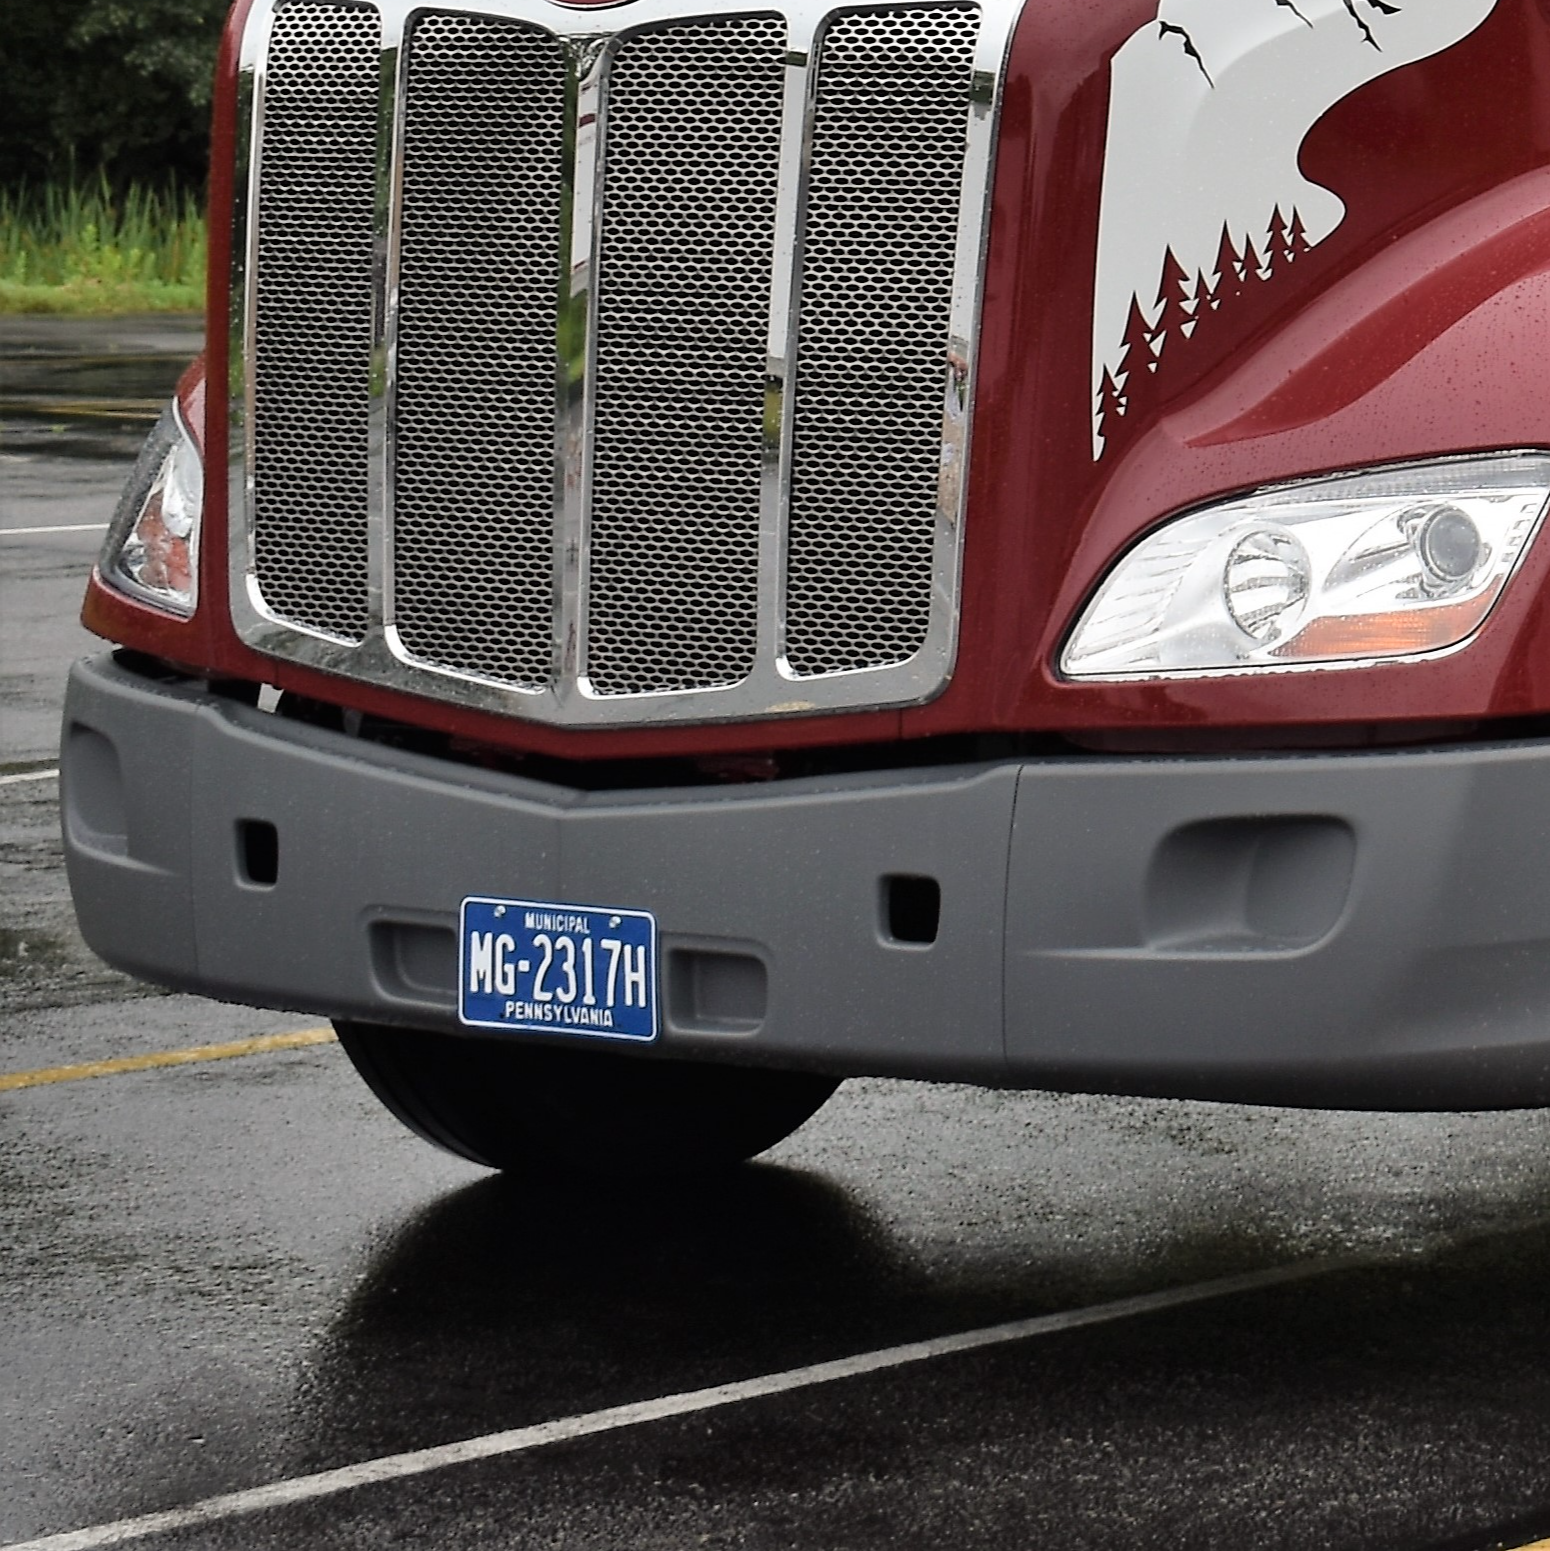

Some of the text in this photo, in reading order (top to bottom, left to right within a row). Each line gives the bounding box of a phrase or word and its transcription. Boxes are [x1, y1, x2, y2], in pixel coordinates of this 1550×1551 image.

[525, 912, 590, 934] MUNICIPAL
[469, 930, 646, 1008] MG-2317H
[505, 1001, 613, 1028] PENNSYLVANIA
